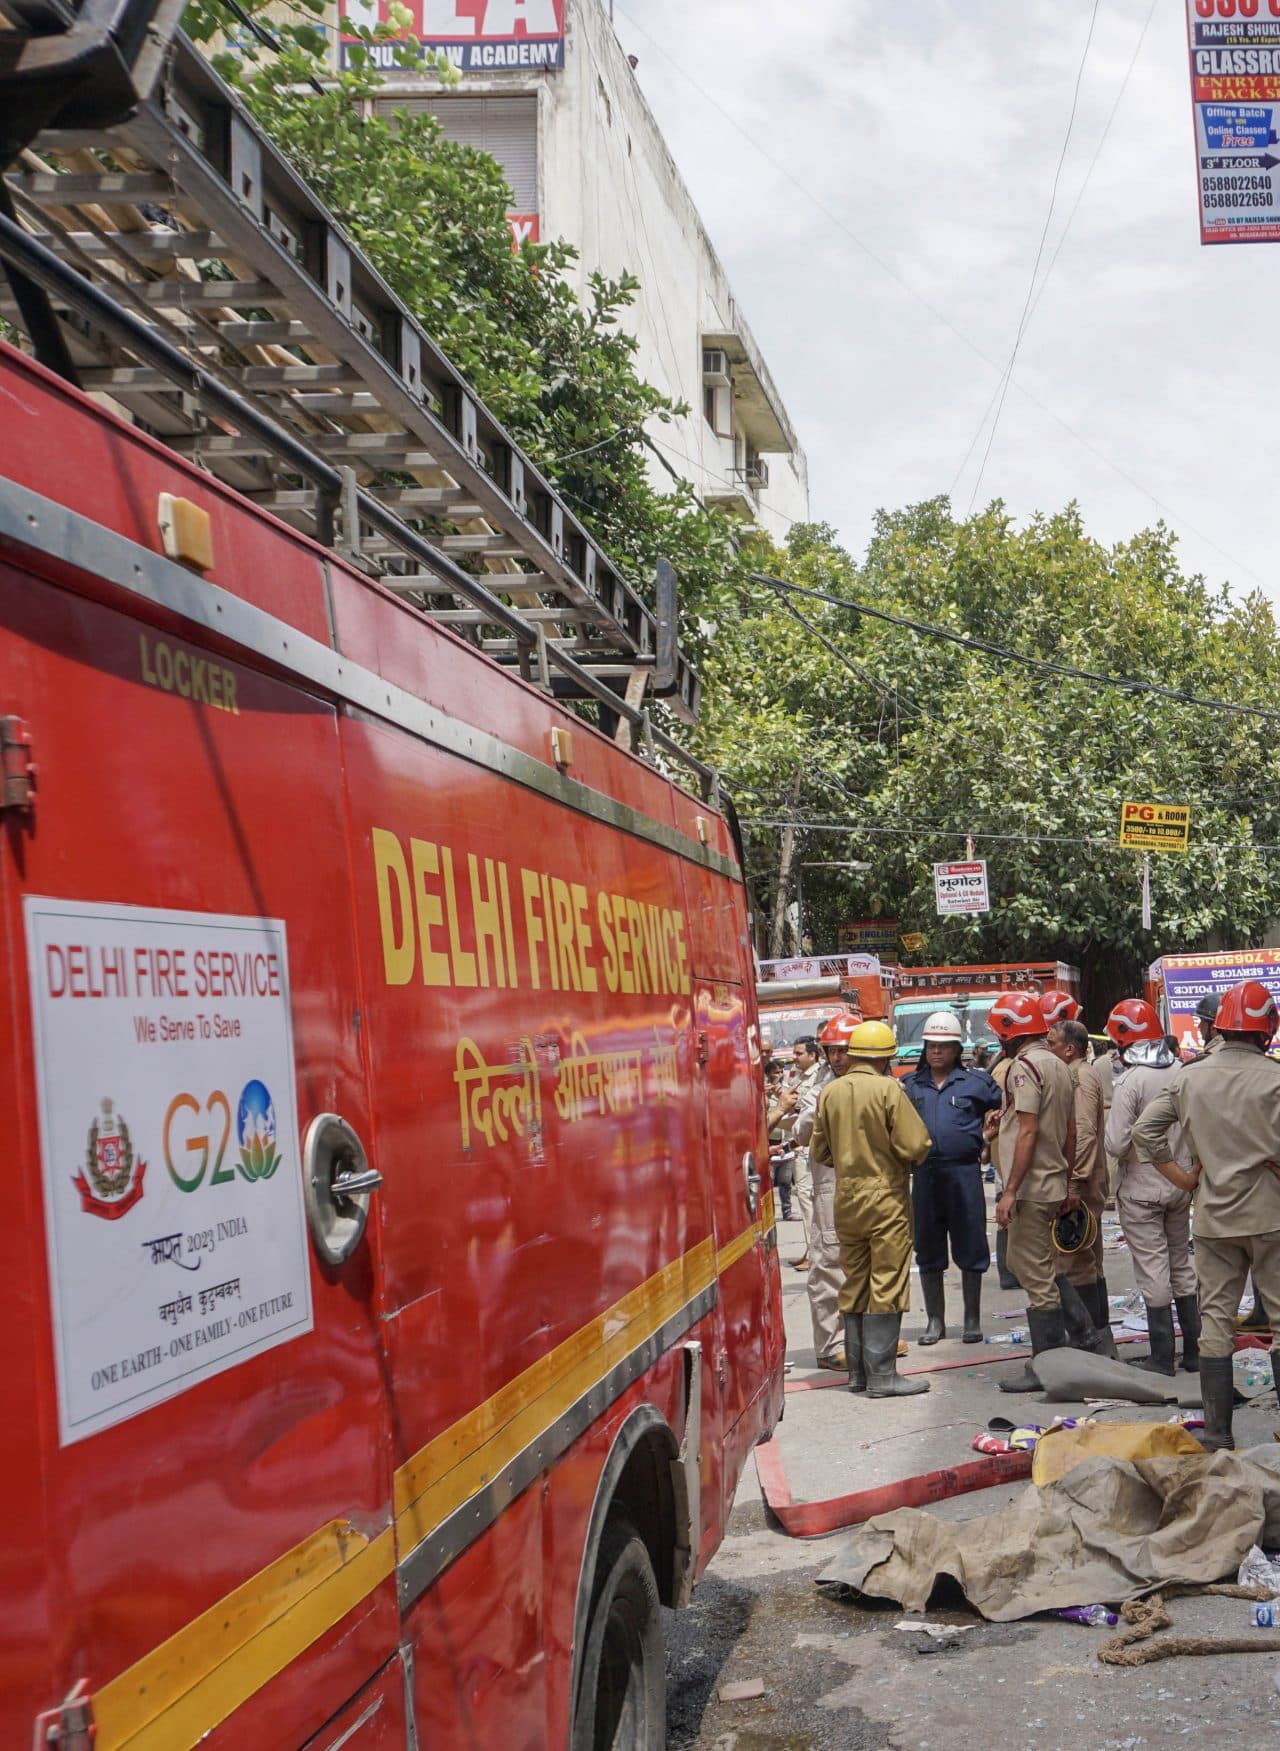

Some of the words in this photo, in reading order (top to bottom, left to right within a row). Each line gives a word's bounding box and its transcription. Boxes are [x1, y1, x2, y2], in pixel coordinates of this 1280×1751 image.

[1202, 24, 1244, 36] RAJESH
[470, 43, 558, 65] ACADEMY
[1200, 76, 1257, 88] ENTRY
[1212, 88, 1261, 99] BACK
[1206, 108, 1236, 117] Offline
[1239, 108, 1265, 118] Batch
[1208, 126, 1233, 135] Online
[1236, 126, 1267, 135] Classes
[1222, 135, 1255, 147] Free
[1222, 159, 1260, 168] FLOOR
[1202, 176, 1272, 191] 8588022640
[1203, 192, 1273, 208] 8588022650
[139, 634, 240, 716] LOCKER
[1125, 805, 1154, 820] PG
[1165, 811, 1187, 822] ROOM
[939, 874, 982, 891] भूगोल
[372, 826, 517, 989] DELHI
[521, 869, 599, 993] FIRE
[598, 891, 692, 996] SERVICE
[46, 944, 129, 999] DELHI
[134, 947, 187, 998] FIRE
[195, 951, 281, 998] SERVICE
[1211, 967, 1264, 979] SERVICES
[1174, 985, 1214, 995] POLICE
[134, 1014, 156, 1044] We
[159, 1014, 195, 1042] Serve
[198, 1015, 213, 1040] To
[214, 1014, 241, 1040] Save
[186, 1229, 215, 1257] 2023
[217, 1216, 248, 1242] INDIA
[159, 1291, 193, 1325] वसुधैव
[91, 1363, 119, 1391] ONE
[121, 1346, 162, 1378] EARTH
[169, 1334, 193, 1358] ONE
[195, 1316, 233, 1347] FAMILY
[238, 1307, 259, 1329] ONE
[260, 1292, 294, 1321] FUTURE
